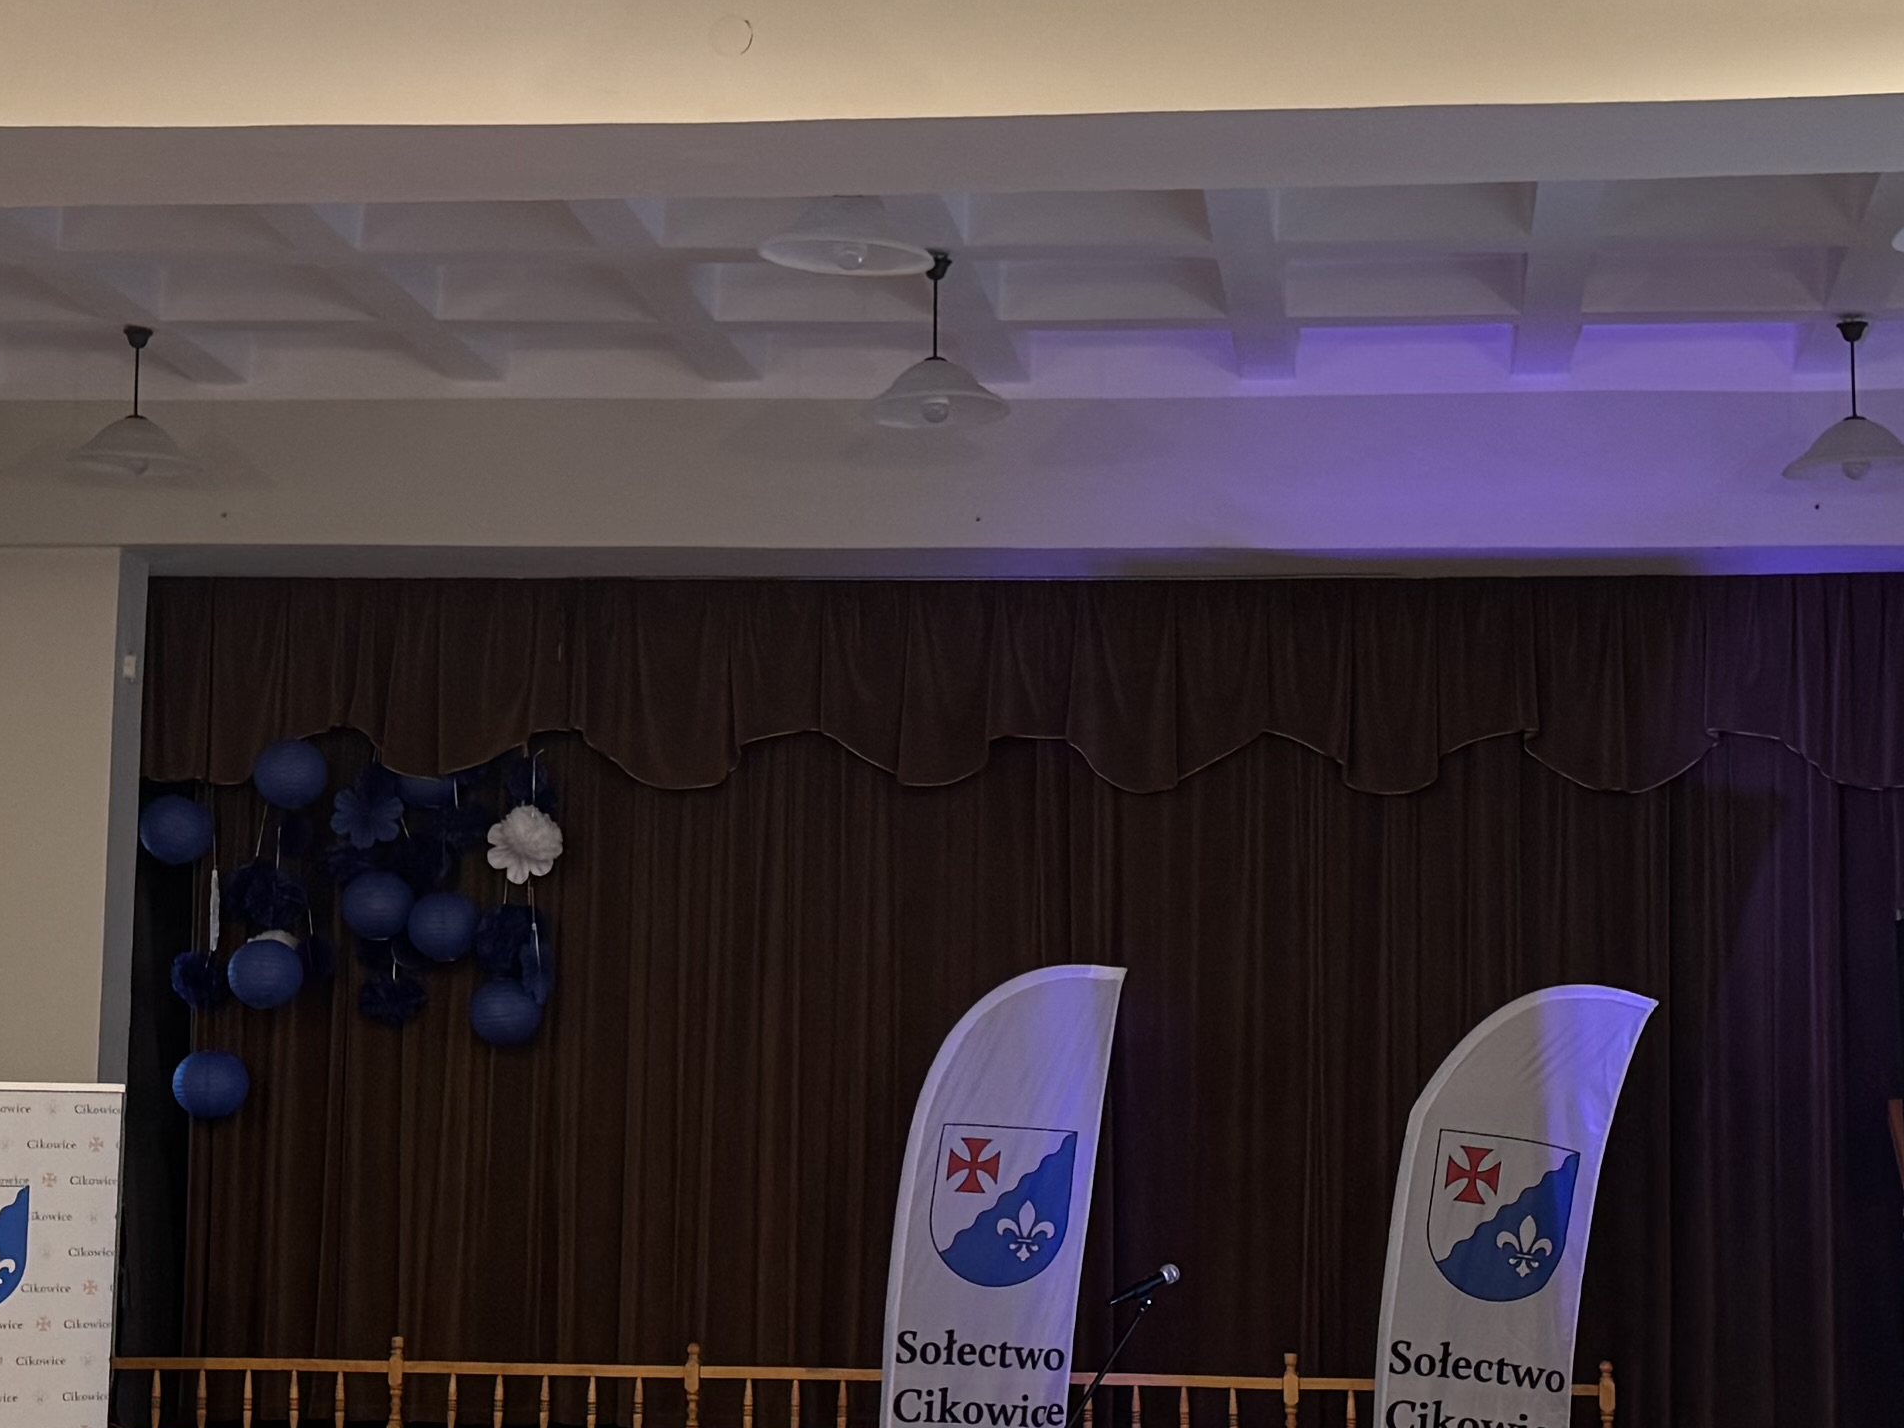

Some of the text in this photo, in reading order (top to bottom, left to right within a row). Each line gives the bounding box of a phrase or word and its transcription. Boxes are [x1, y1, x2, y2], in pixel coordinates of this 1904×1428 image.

[26, 1138, 77, 1150] Cikowice
[20, 1282, 72, 1293] Cikowice
[15, 1355, 67, 1367] Cikowice
[896, 1329, 1065, 1371] Sołectwo
[1389, 1339, 1565, 1393] Sołectwo
[893, 1386, 1065, 1428] Cikowice
